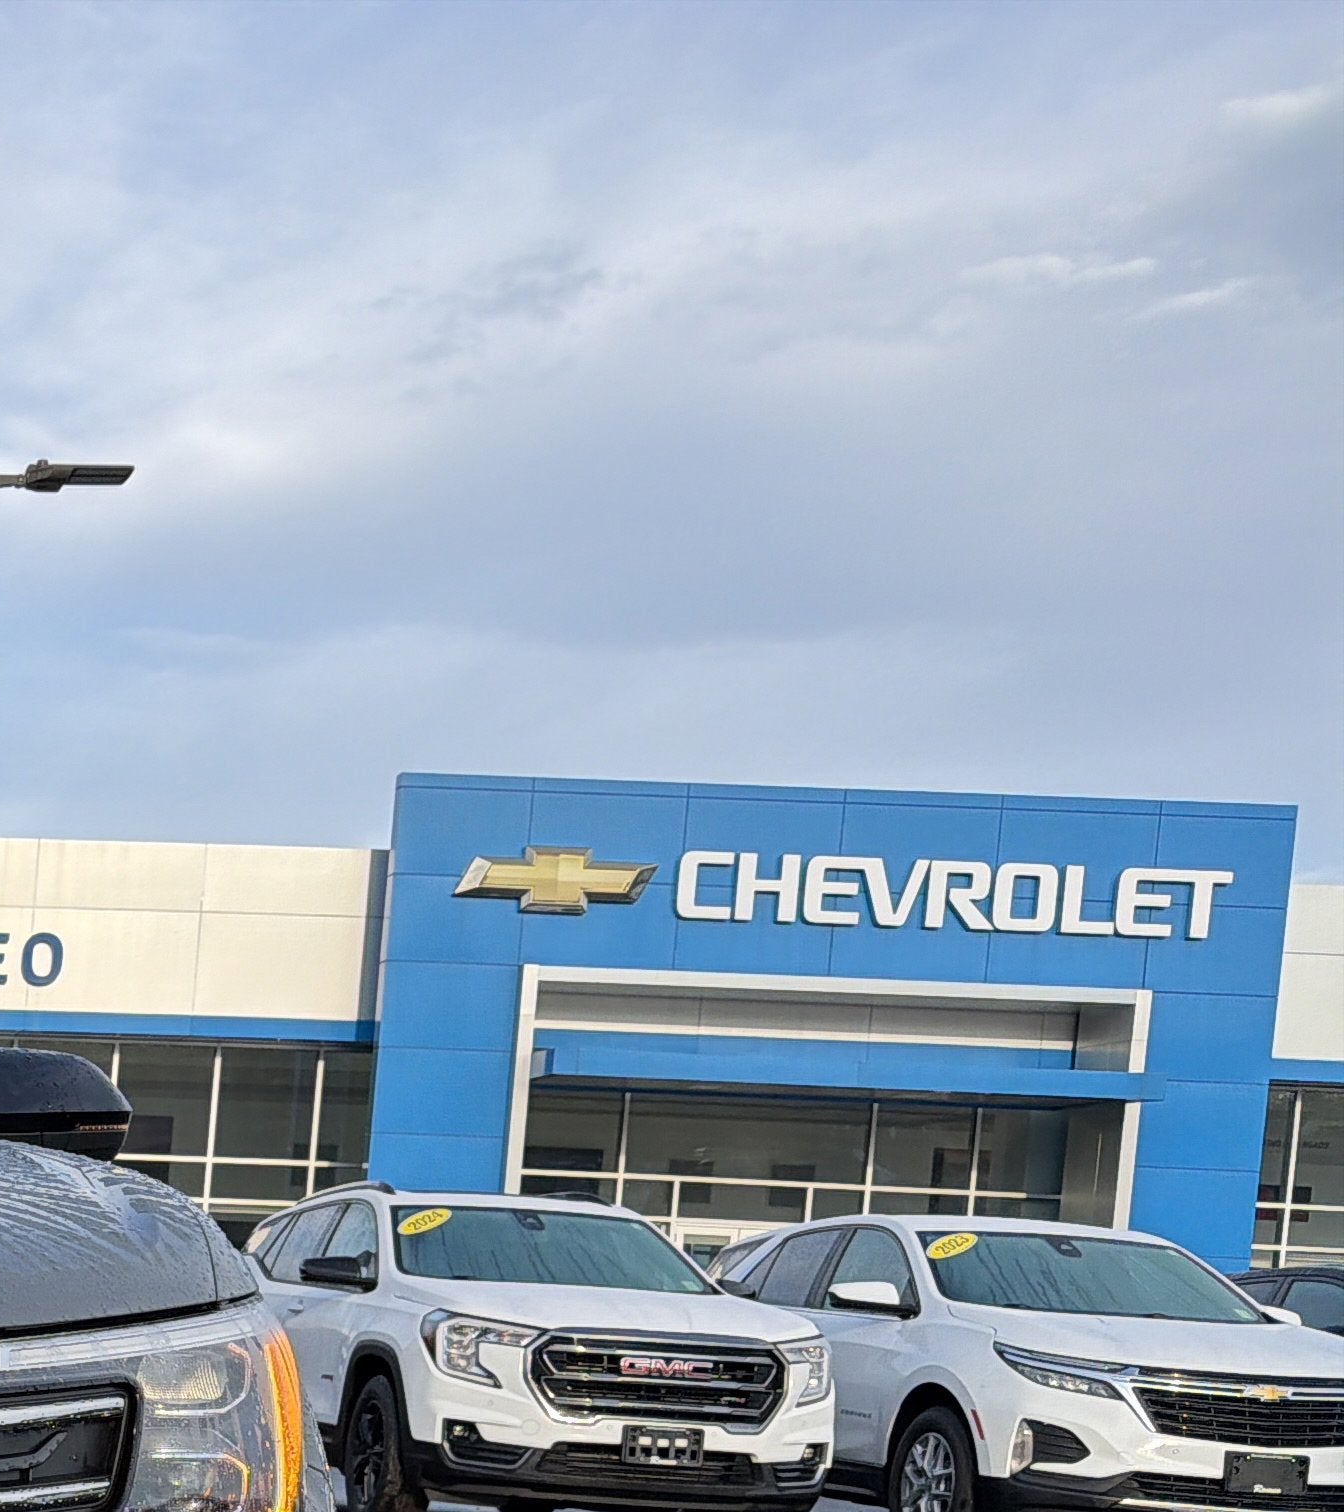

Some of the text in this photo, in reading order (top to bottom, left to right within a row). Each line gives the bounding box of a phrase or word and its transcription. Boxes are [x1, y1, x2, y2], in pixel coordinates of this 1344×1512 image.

[674, 849, 1235, 940] CHEVROLET
[407, 1210, 444, 1231] 2024
[934, 1234, 970, 1255] 2023
[619, 1356, 714, 1380] GMC
